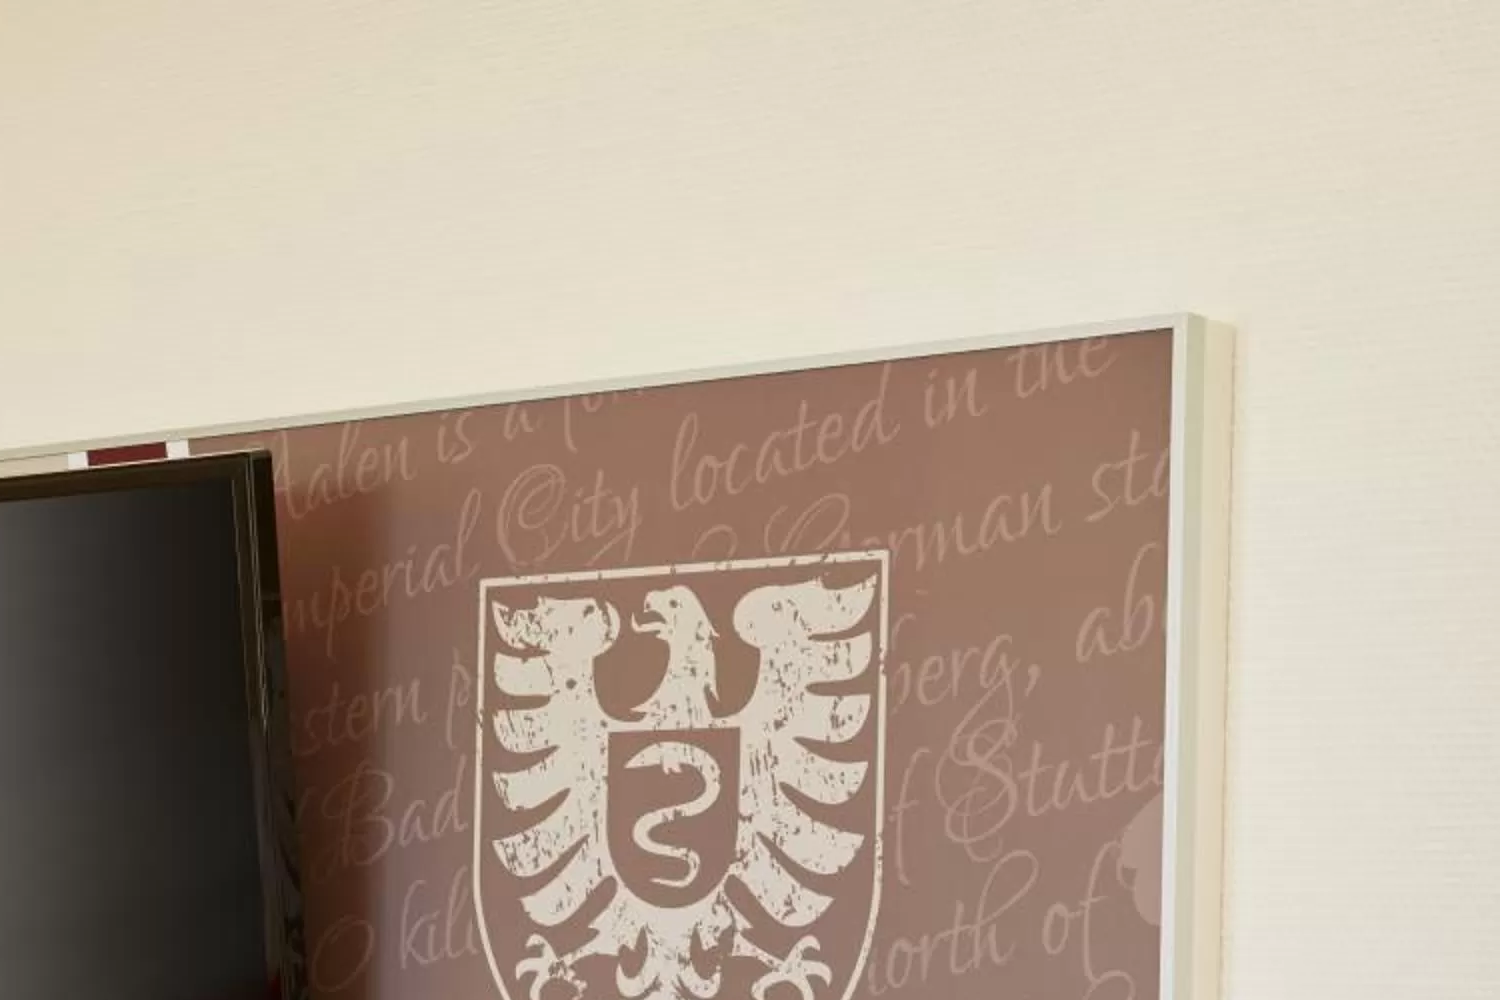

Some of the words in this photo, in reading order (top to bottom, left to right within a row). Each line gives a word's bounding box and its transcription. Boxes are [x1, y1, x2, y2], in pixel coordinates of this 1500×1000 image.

[437, 412, 475, 464] is
[282, 486, 482, 664] mperial
[497, 463, 640, 571] City
[671, 362, 900, 511] located
[924, 367, 988, 428] in
[291, 677, 428, 757] stern
[765, 484, 1062, 572] Grman
[1076, 542, 1164, 664] ab
[935, 714, 1164, 862] Stutt
[1042, 840, 1120, 983] of
